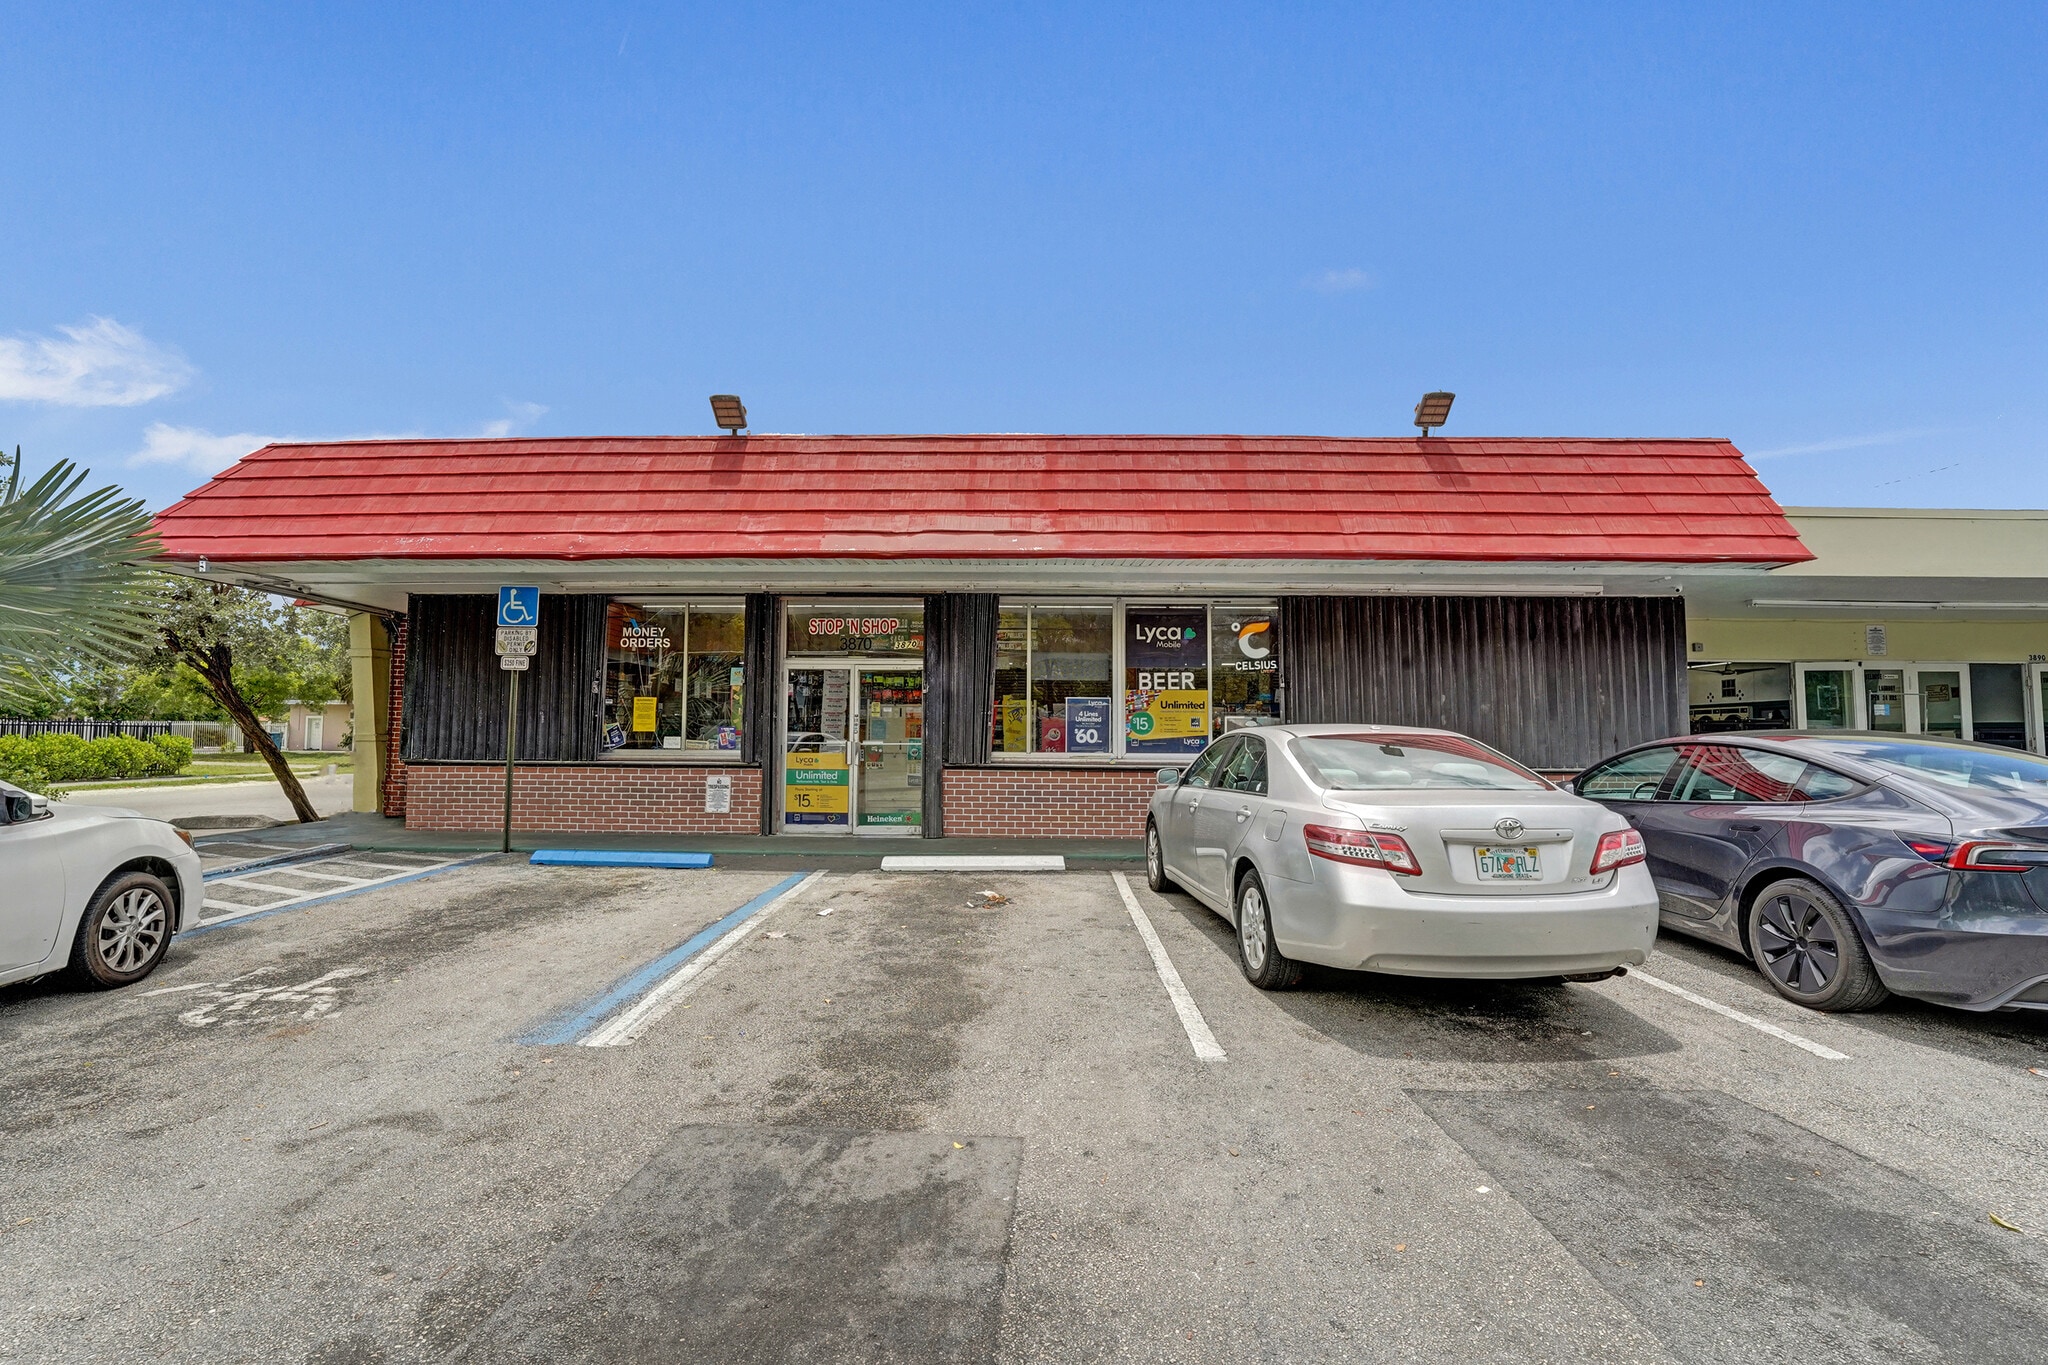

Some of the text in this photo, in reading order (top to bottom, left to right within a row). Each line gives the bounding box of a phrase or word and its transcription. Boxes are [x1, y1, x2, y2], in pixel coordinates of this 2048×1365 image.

[622, 627, 666, 637] MONEY
[808, 618, 844, 635] STOP
[846, 618, 860, 635] 'N
[862, 618, 898, 635] SHOP
[1136, 624, 1181, 643] Lyca
[620, 638, 670, 648] ORDERS
[840, 638, 872, 650] 3870
[1235, 660, 1278, 670] CELSIUS
[1138, 672, 1196, 690] BEER
[1160, 701, 1205, 709] Unlimited
[1133, 718, 1148, 730] $15
[1074, 728, 1098, 744] $60
[796, 757, 814, 766] Lyca
[796, 770, 838, 780] Unlimited
[794, 794, 810, 807] $15
[1369, 822, 1408, 832] Camry
